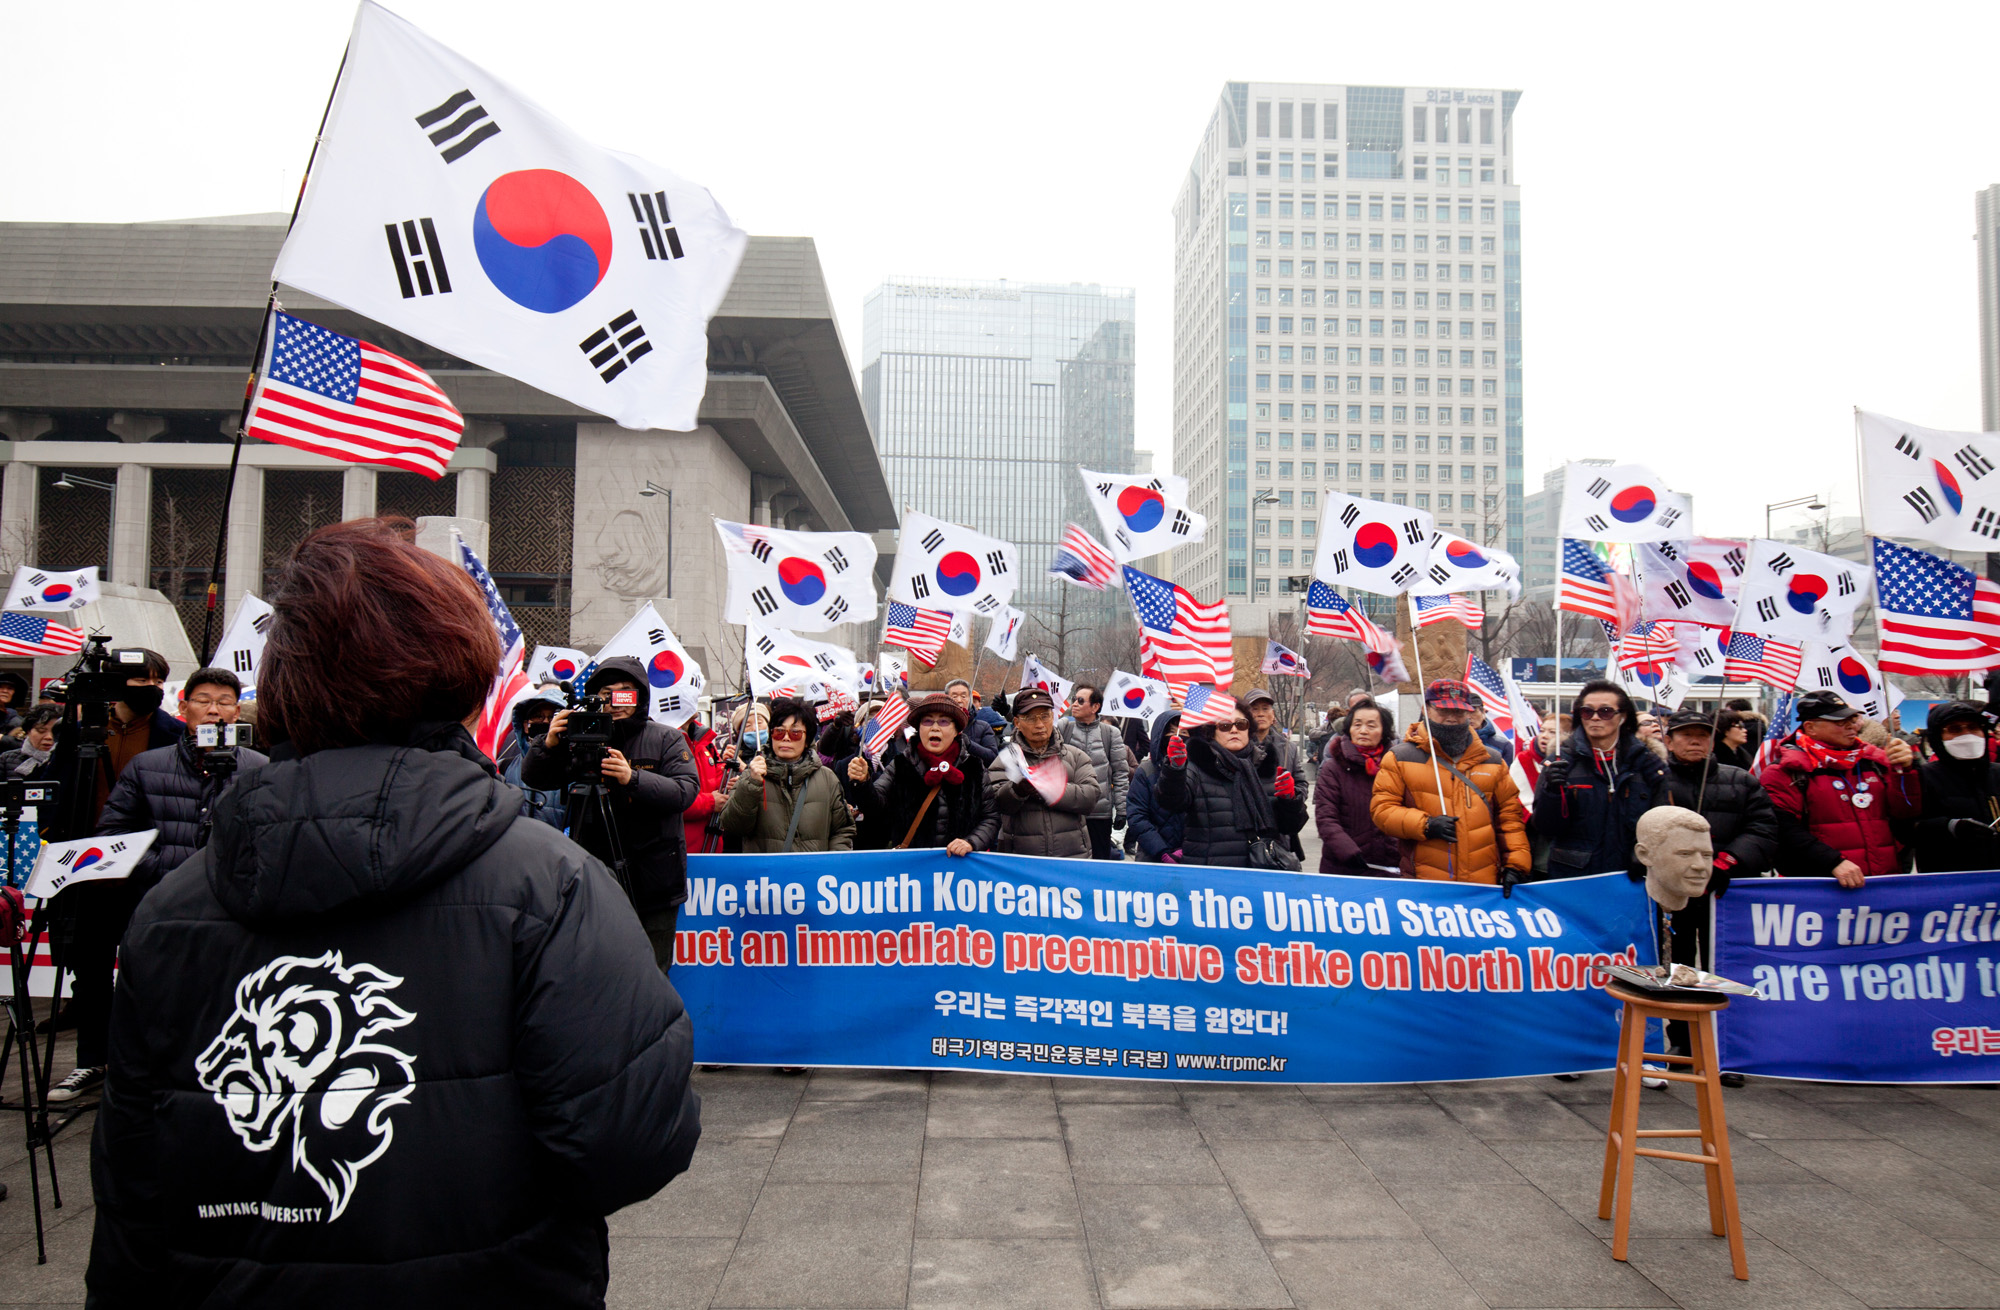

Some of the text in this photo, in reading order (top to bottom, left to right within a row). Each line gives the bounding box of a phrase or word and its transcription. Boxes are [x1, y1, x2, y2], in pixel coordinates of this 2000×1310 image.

[1426, 89, 1494, 104] 외교부 MOFA
[817, 875, 921, 915] South
[933, 872, 1083, 919] Koreans
[1093, 889, 1179, 927] urge
[1189, 889, 1253, 930] the
[1263, 891, 1390, 935] United
[1397, 899, 1517, 938] States
[1517, 907, 1562, 938] to
[1751, 902, 2000, 946] We the citi
[672, 926, 734, 966] uct
[741, 930, 788, 966] an
[796, 922, 995, 968] immediate
[1003, 932, 1224, 981] preemptive
[1235, 942, 1352, 986] strike
[1360, 951, 1411, 990] on
[1418, 946, 1523, 992] North
[1752, 956, 2000, 1002] are ready t
[935, 990, 1288, 1035] 우리는 즉각적인 북폭을 원한다!
[931, 1037, 1119, 1066] 태극기혁명국민운동본부
[1175, 1054, 1288, 1072] www.trpmc.kr
[1932, 1027, 2000, 1056] 우리는
[198, 1201, 259, 1218] HANYANG
